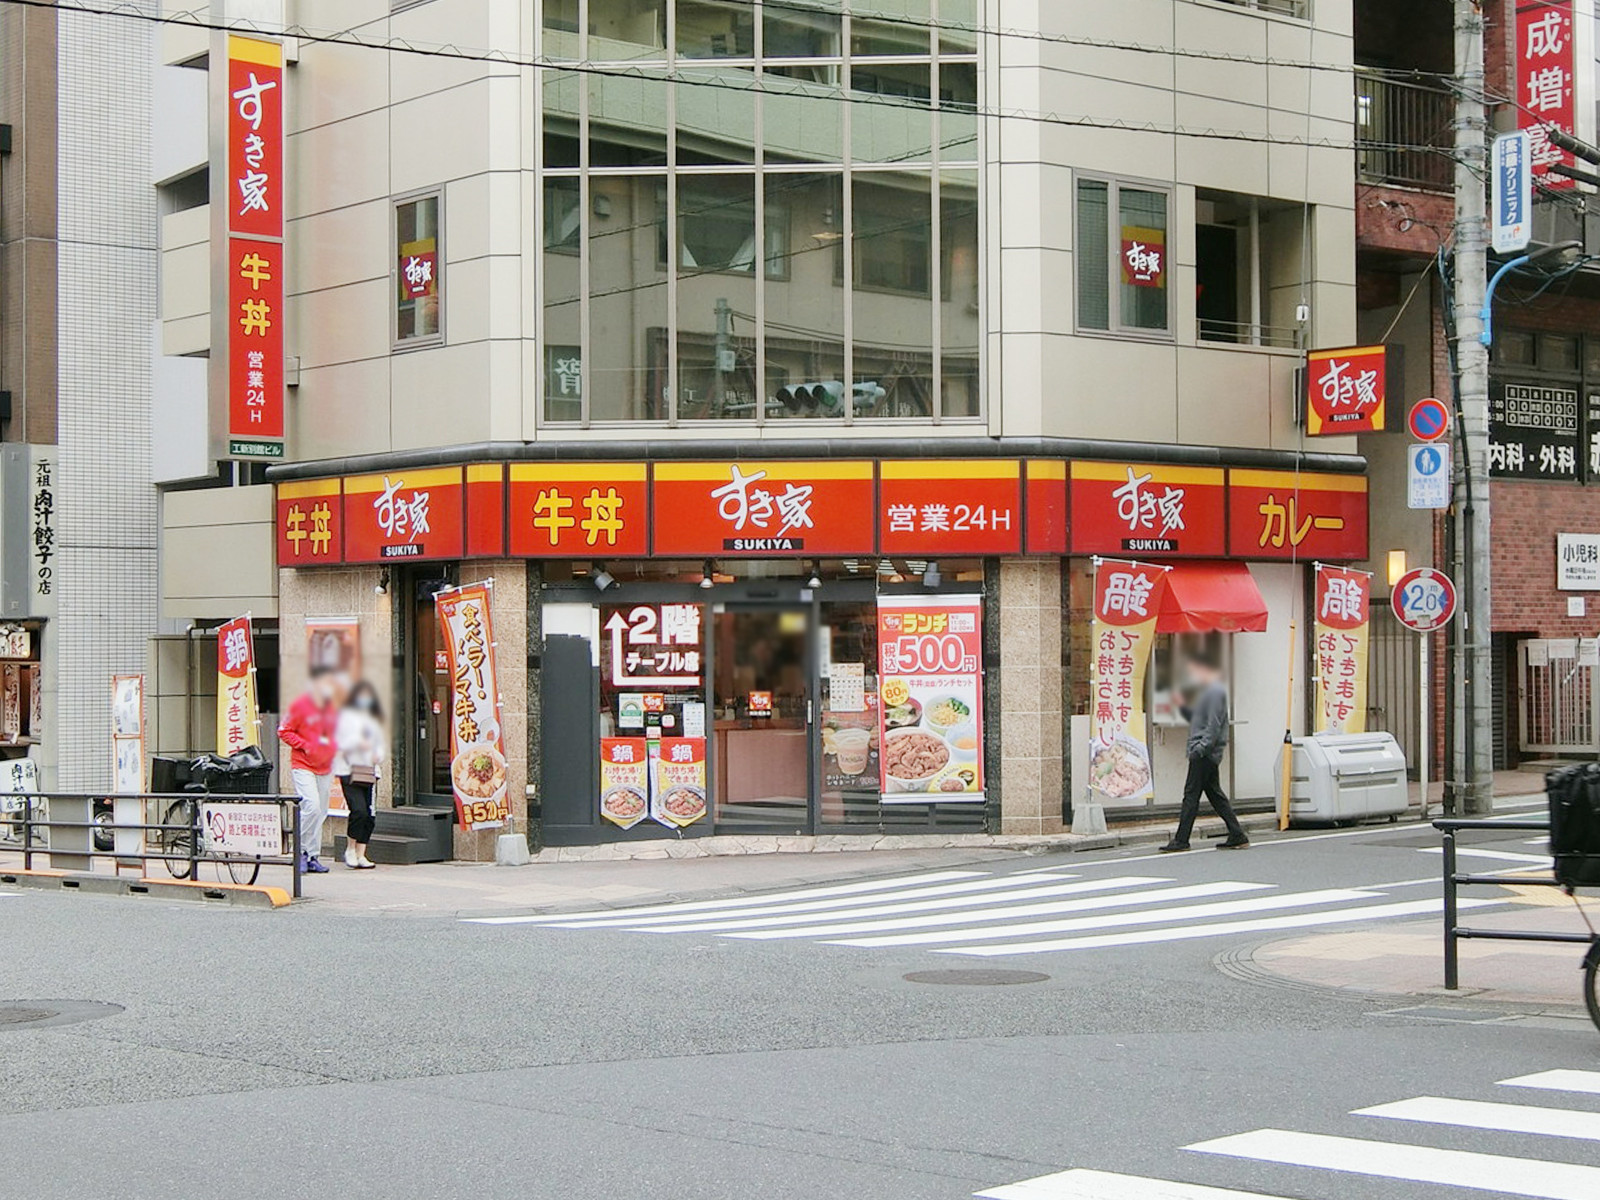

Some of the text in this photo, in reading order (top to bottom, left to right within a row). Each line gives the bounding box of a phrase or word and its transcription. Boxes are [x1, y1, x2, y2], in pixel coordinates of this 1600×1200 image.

[233, 72, 276, 216] すき家
[405, 256, 432, 285] すき家
[1126, 240, 1160, 275] すき家
[240, 252, 271, 337] 牛丼
[246, 351, 266, 423] 営業24H
[1318, 358, 1377, 411] すき家
[1333, 413, 1360, 421] SUKIYA
[373, 476, 431, 543] すき家
[532, 487, 625, 546] 牛丼
[711, 464, 815, 538] すき家
[887, 503, 1011, 533] 営業24H
[1111, 466, 1185, 538] すき家
[33, 459, 54, 595] 元祖肉汁餃子の店
[286, 502, 332, 556] 牛丼
[1259, 495, 1344, 549] カレー
[385, 545, 418, 557] SUKIYA
[733, 538, 793, 550] SUKIYA
[1128, 539, 1170, 551] SUKIYA
[1563, 543, 1598, 563] 小児科
[628, 604, 699, 645] 2階
[903, 613, 948, 633] ランチ
[225, 627, 248, 671] 鍋
[626, 652, 699, 672] テーブル席
[883, 643, 898, 673] 税込
[898, 634, 977, 673] 500円
[612, 745, 634, 762] 鍋
[671, 744, 693, 762] 鍋
